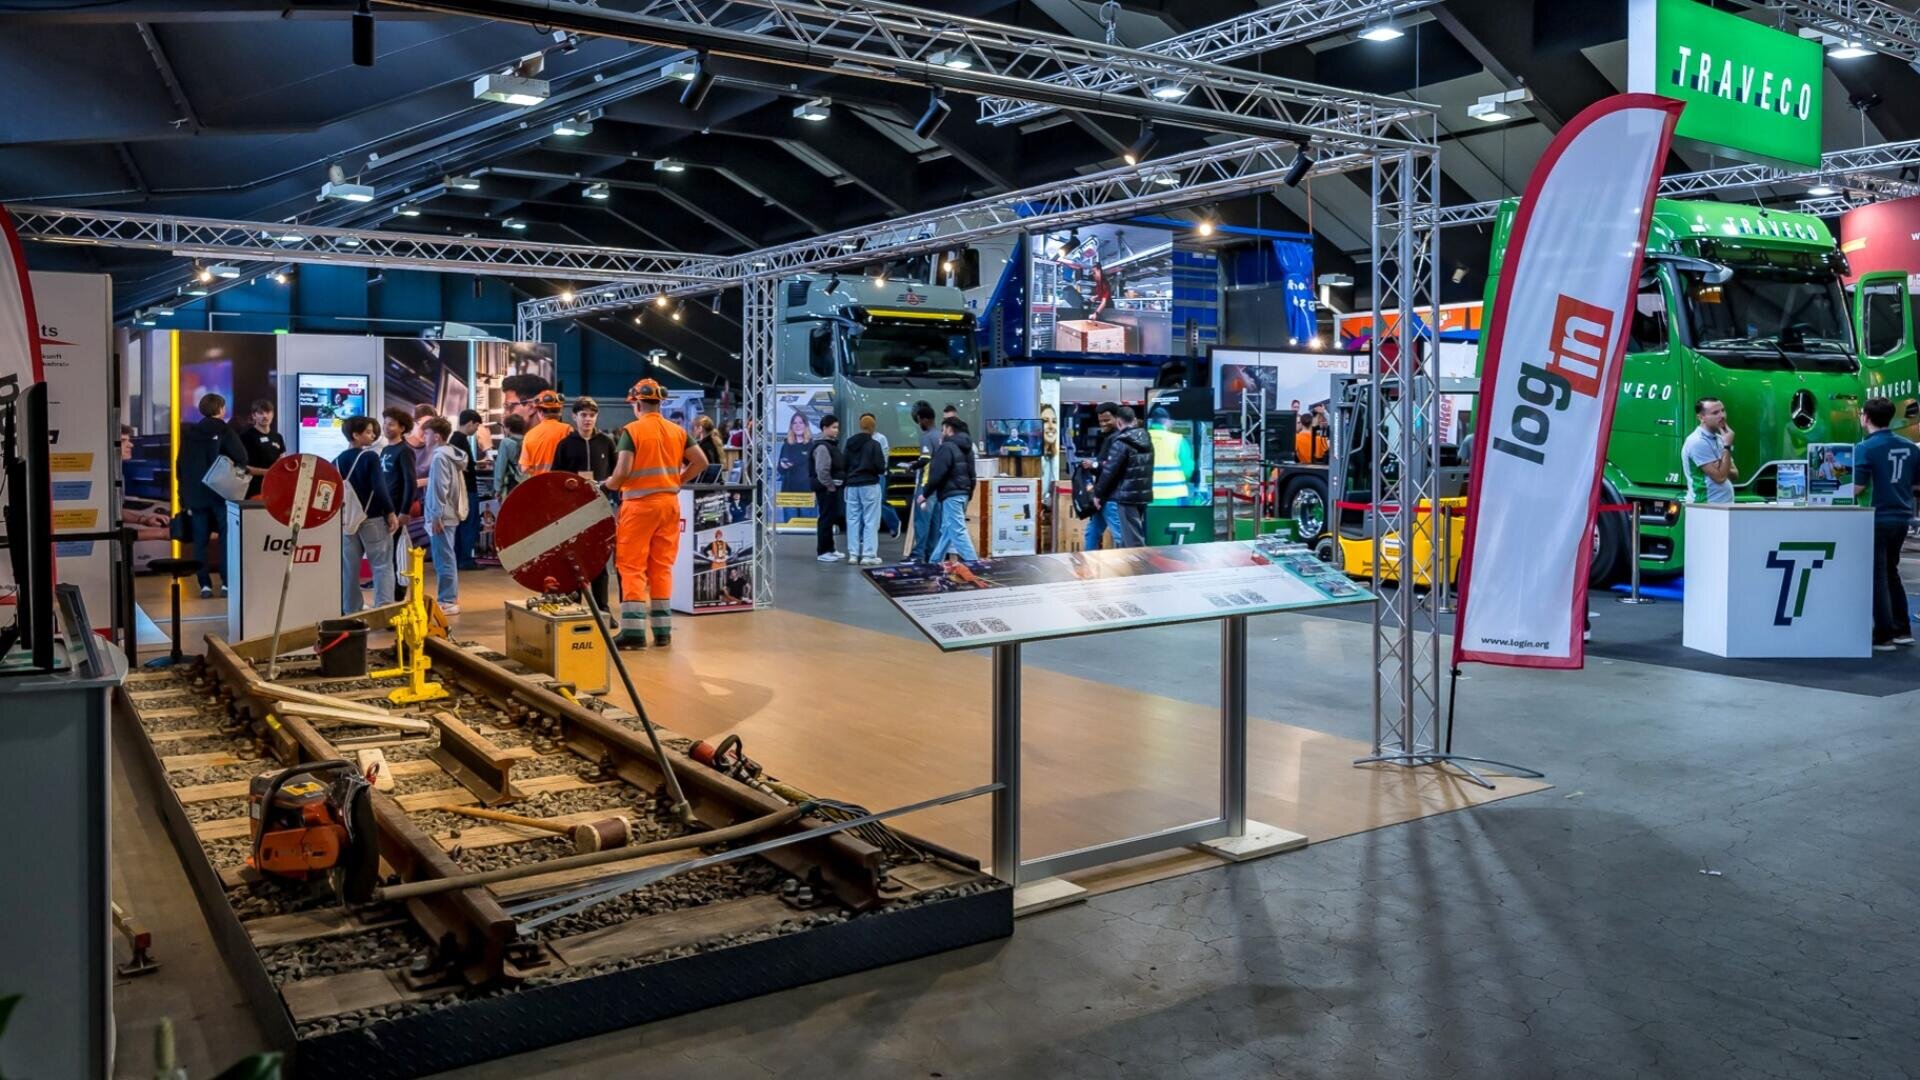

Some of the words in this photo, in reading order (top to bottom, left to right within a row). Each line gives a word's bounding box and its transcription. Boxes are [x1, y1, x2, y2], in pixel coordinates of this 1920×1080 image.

[1678, 46, 1811, 121] TRAVECO
[1725, 216, 1819, 241] TRAVECO
[1492, 314, 1607, 466] login
[1866, 379, 1912, 400] TRAVECO
[571, 641, 594, 651] RAIL
[1480, 637, 1550, 650] www.login.org
